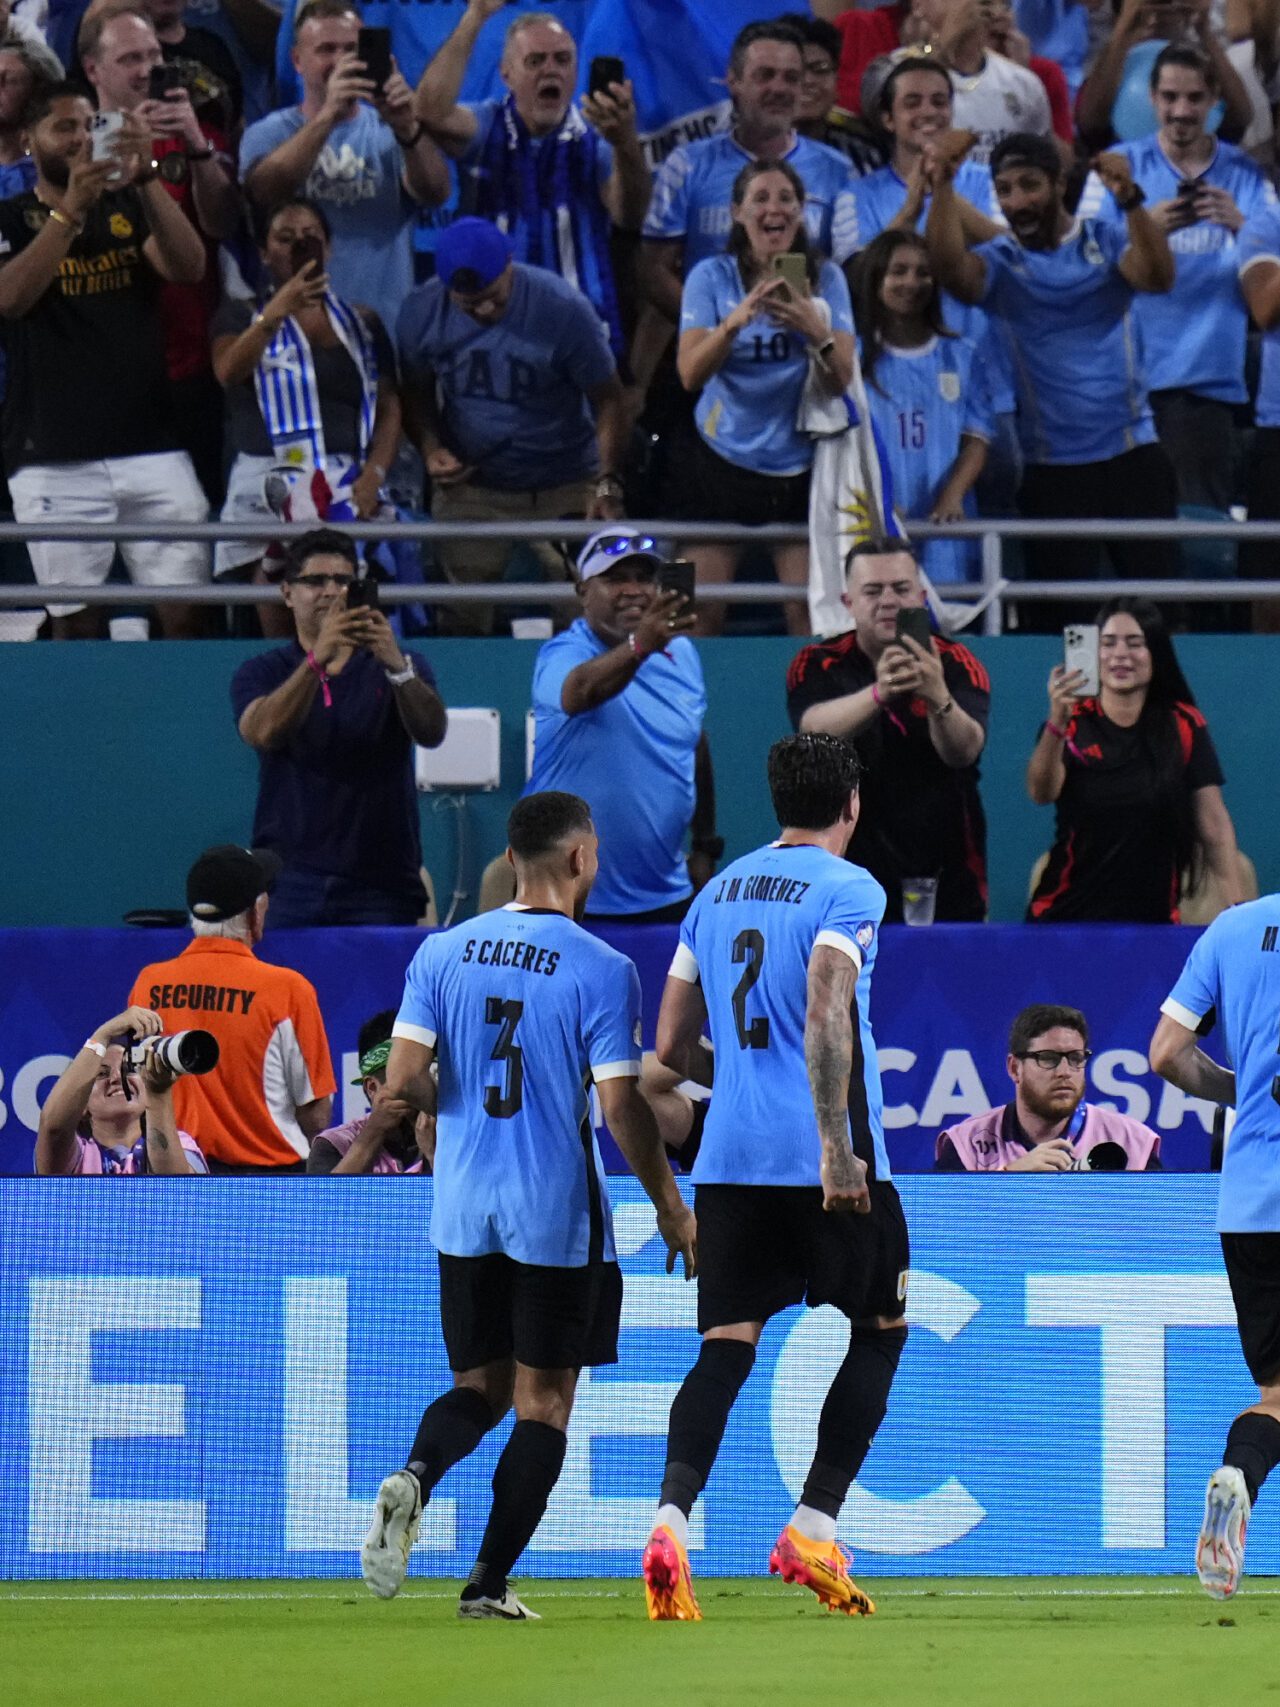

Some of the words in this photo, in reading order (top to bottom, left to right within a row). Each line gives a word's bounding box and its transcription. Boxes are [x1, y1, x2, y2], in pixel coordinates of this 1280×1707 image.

[752, 332, 790, 363] 10
[897, 409, 925, 449] 15
[149, 984, 256, 1015] SECURITY
[731, 928, 770, 1051] 2
[483, 996, 524, 1119] 3
